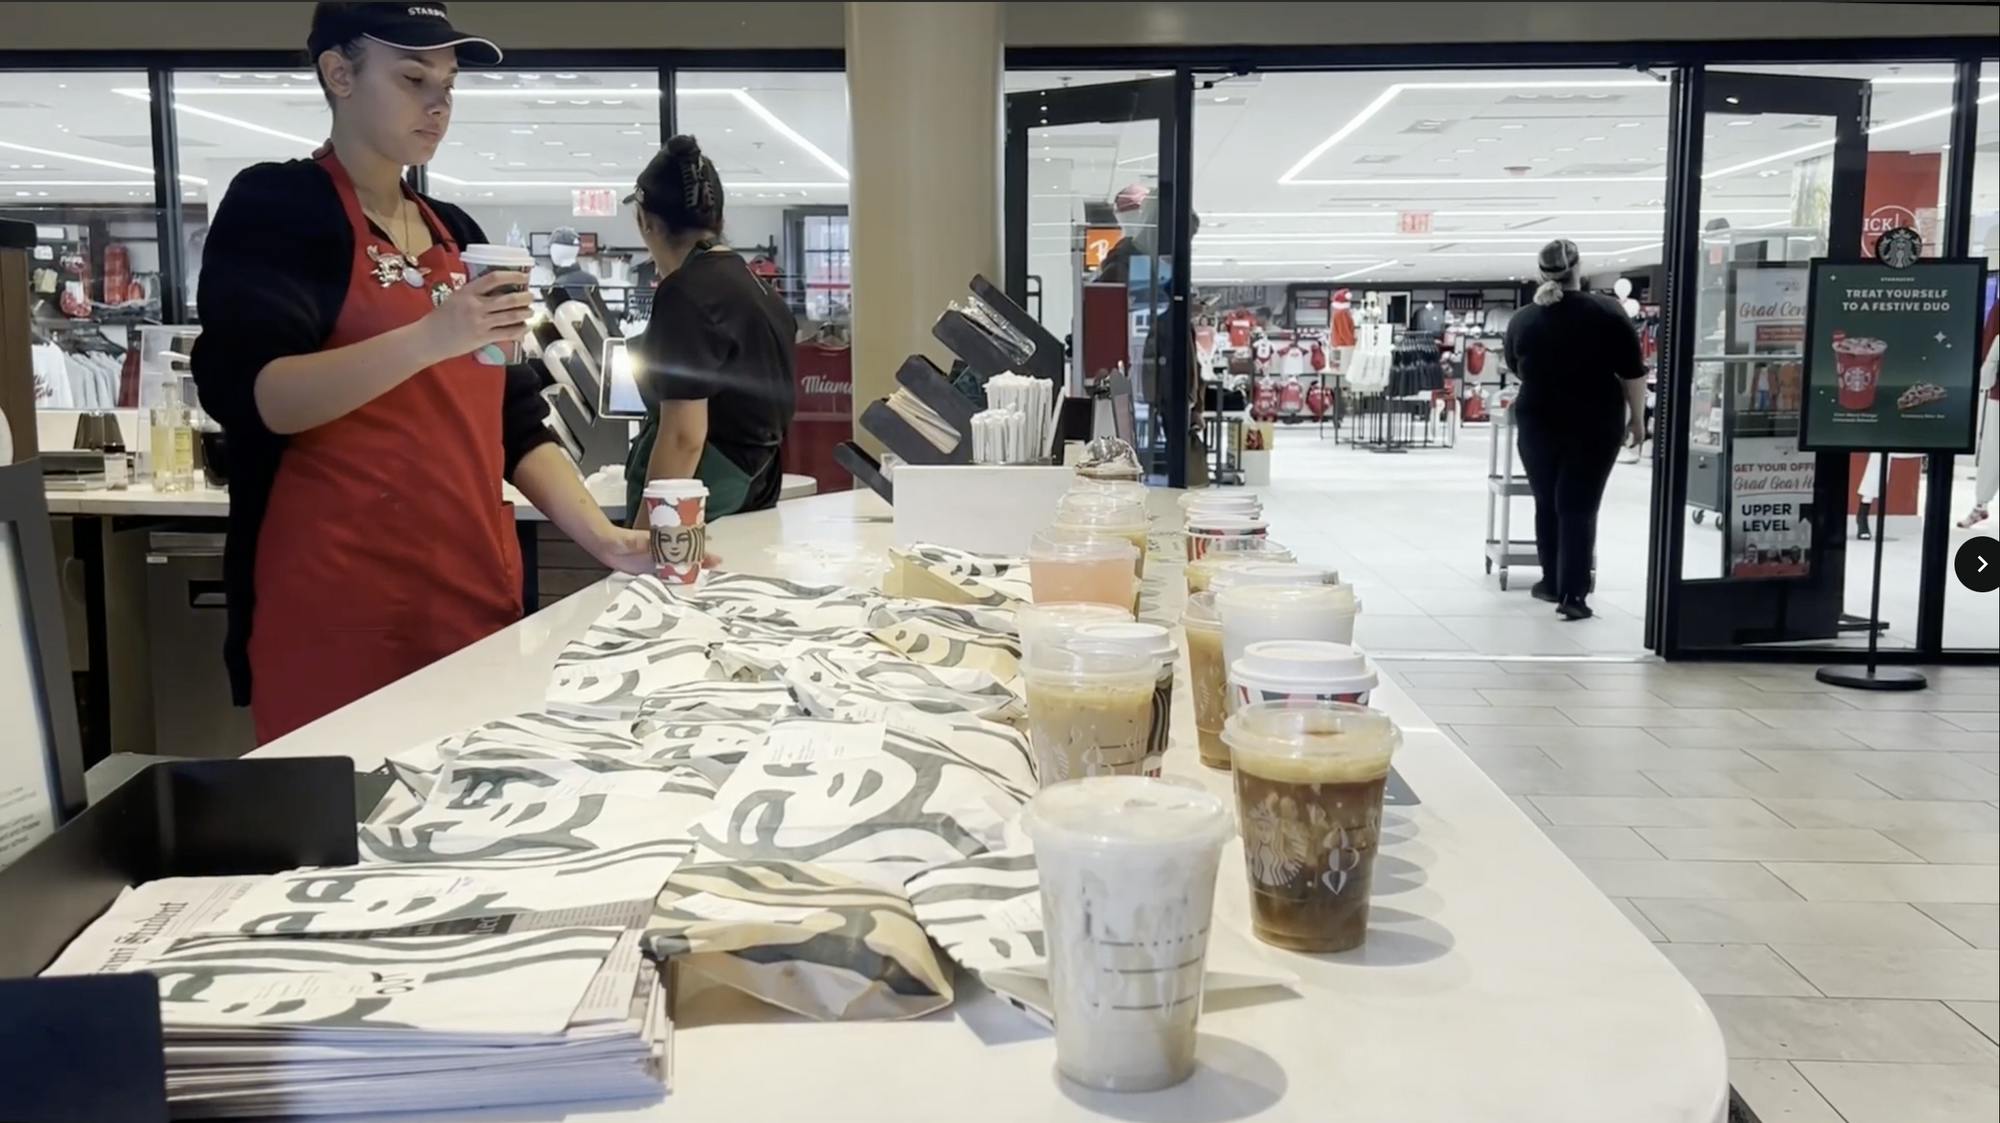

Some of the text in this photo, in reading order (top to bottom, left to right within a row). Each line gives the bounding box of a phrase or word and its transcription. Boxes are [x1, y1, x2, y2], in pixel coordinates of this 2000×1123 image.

[1845, 288, 1948, 299] TREAT YOURSELF
[1739, 301, 1778, 318] Grad
[1842, 301, 1950, 312] TO A FESTIVE DUO
[1734, 463, 1754, 472] GET
[1757, 462, 1787, 472] YOUR
[1734, 476, 1768, 490] Grad
[1770, 475, 1800, 490] Gear
[1742, 503, 1792, 516] UPPER
[1743, 519, 1791, 532] LEVEL
